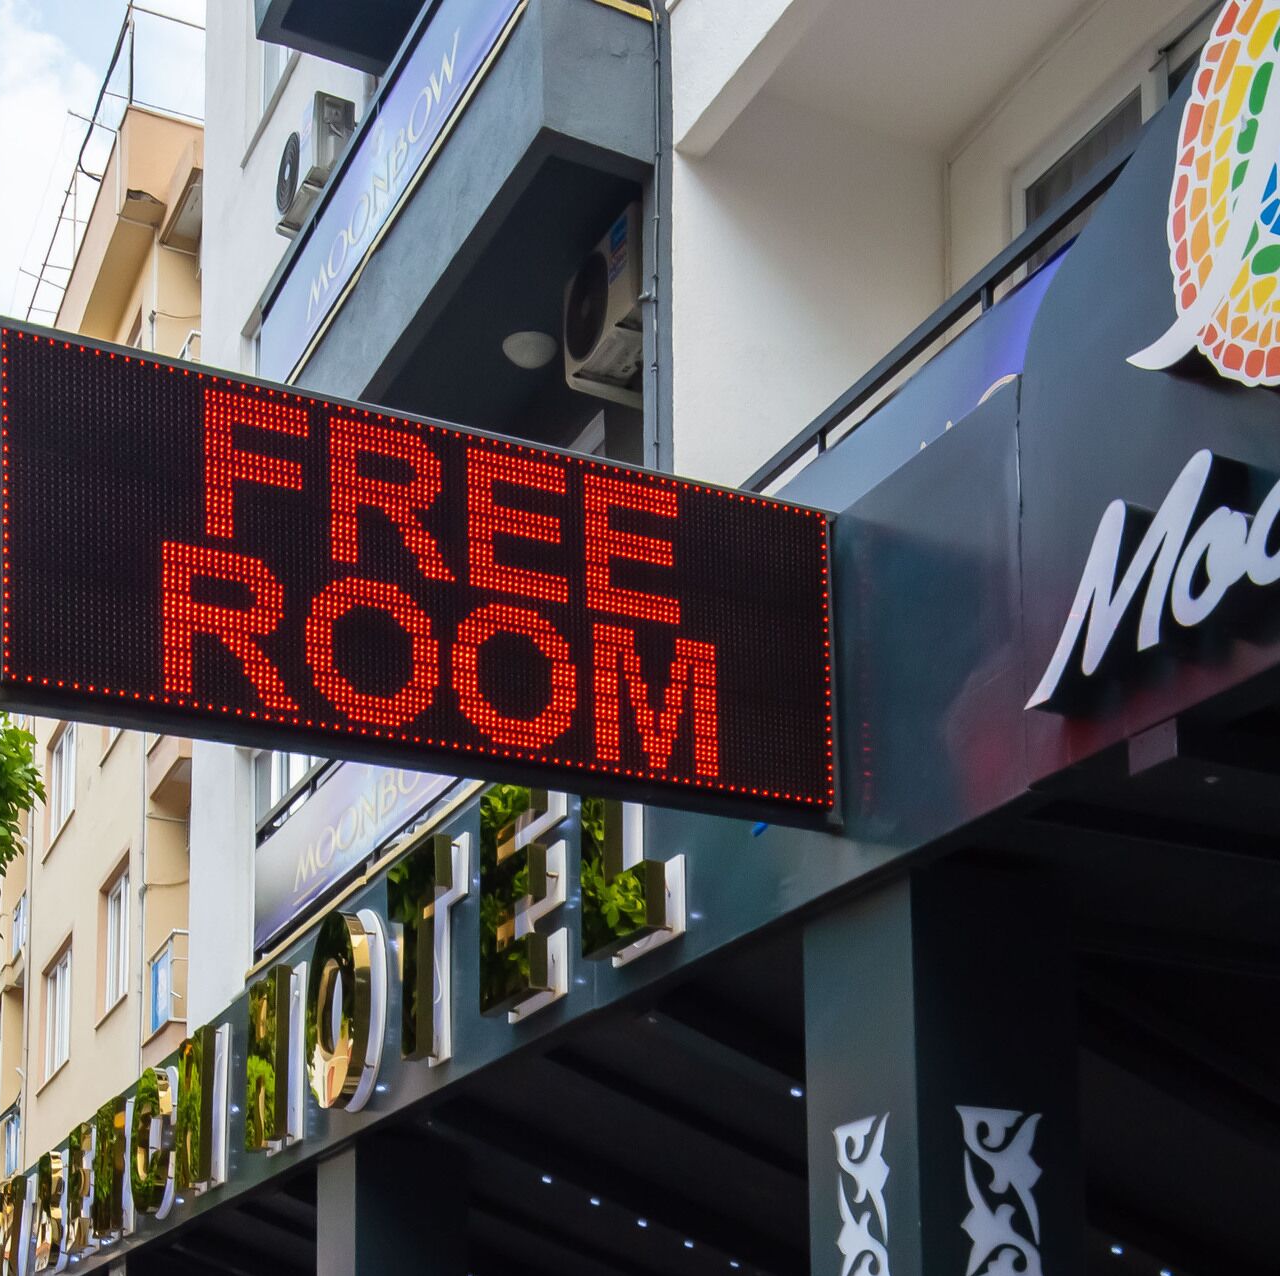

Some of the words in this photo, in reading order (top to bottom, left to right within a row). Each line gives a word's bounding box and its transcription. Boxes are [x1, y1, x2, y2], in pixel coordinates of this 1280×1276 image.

[305, 26, 460, 323] MOONBOW
[203, 387, 681, 626] FREE
[160, 540, 720, 779] ROOM
[293, 768, 421, 893] MOONBO
